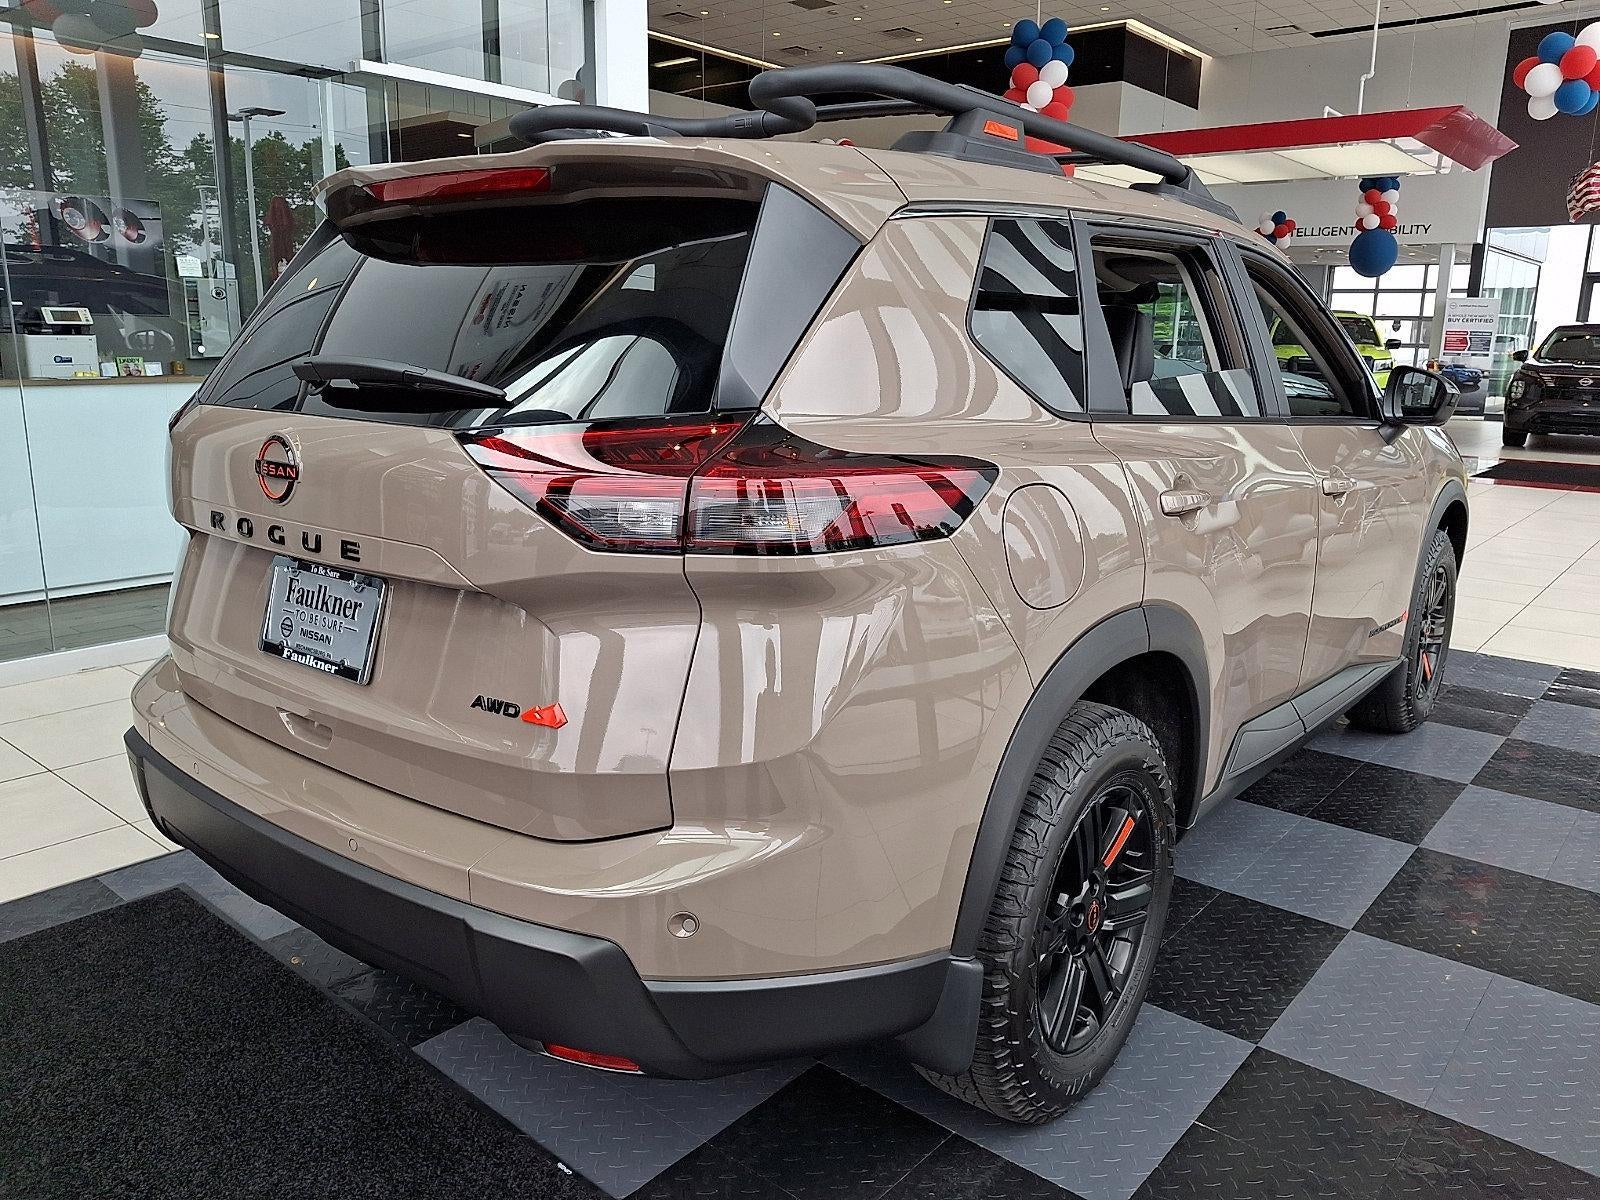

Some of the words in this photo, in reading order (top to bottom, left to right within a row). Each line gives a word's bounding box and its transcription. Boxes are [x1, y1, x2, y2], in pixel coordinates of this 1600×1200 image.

[1290, 226, 1356, 238] TELLIGENT
[210, 510, 361, 562] ROGUE
[310, 564, 318, 573] To
[318, 566, 326, 576] Be
[325, 568, 341, 579] Sure
[285, 576, 363, 621] Faulkner
[295, 609, 307, 622] TO
[308, 613, 319, 626] BE
[321, 616, 344, 633] SURE
[299, 627, 333, 646] NISSAN
[281, 647, 338, 674] Faulkner
[470, 694, 521, 719] AWD
